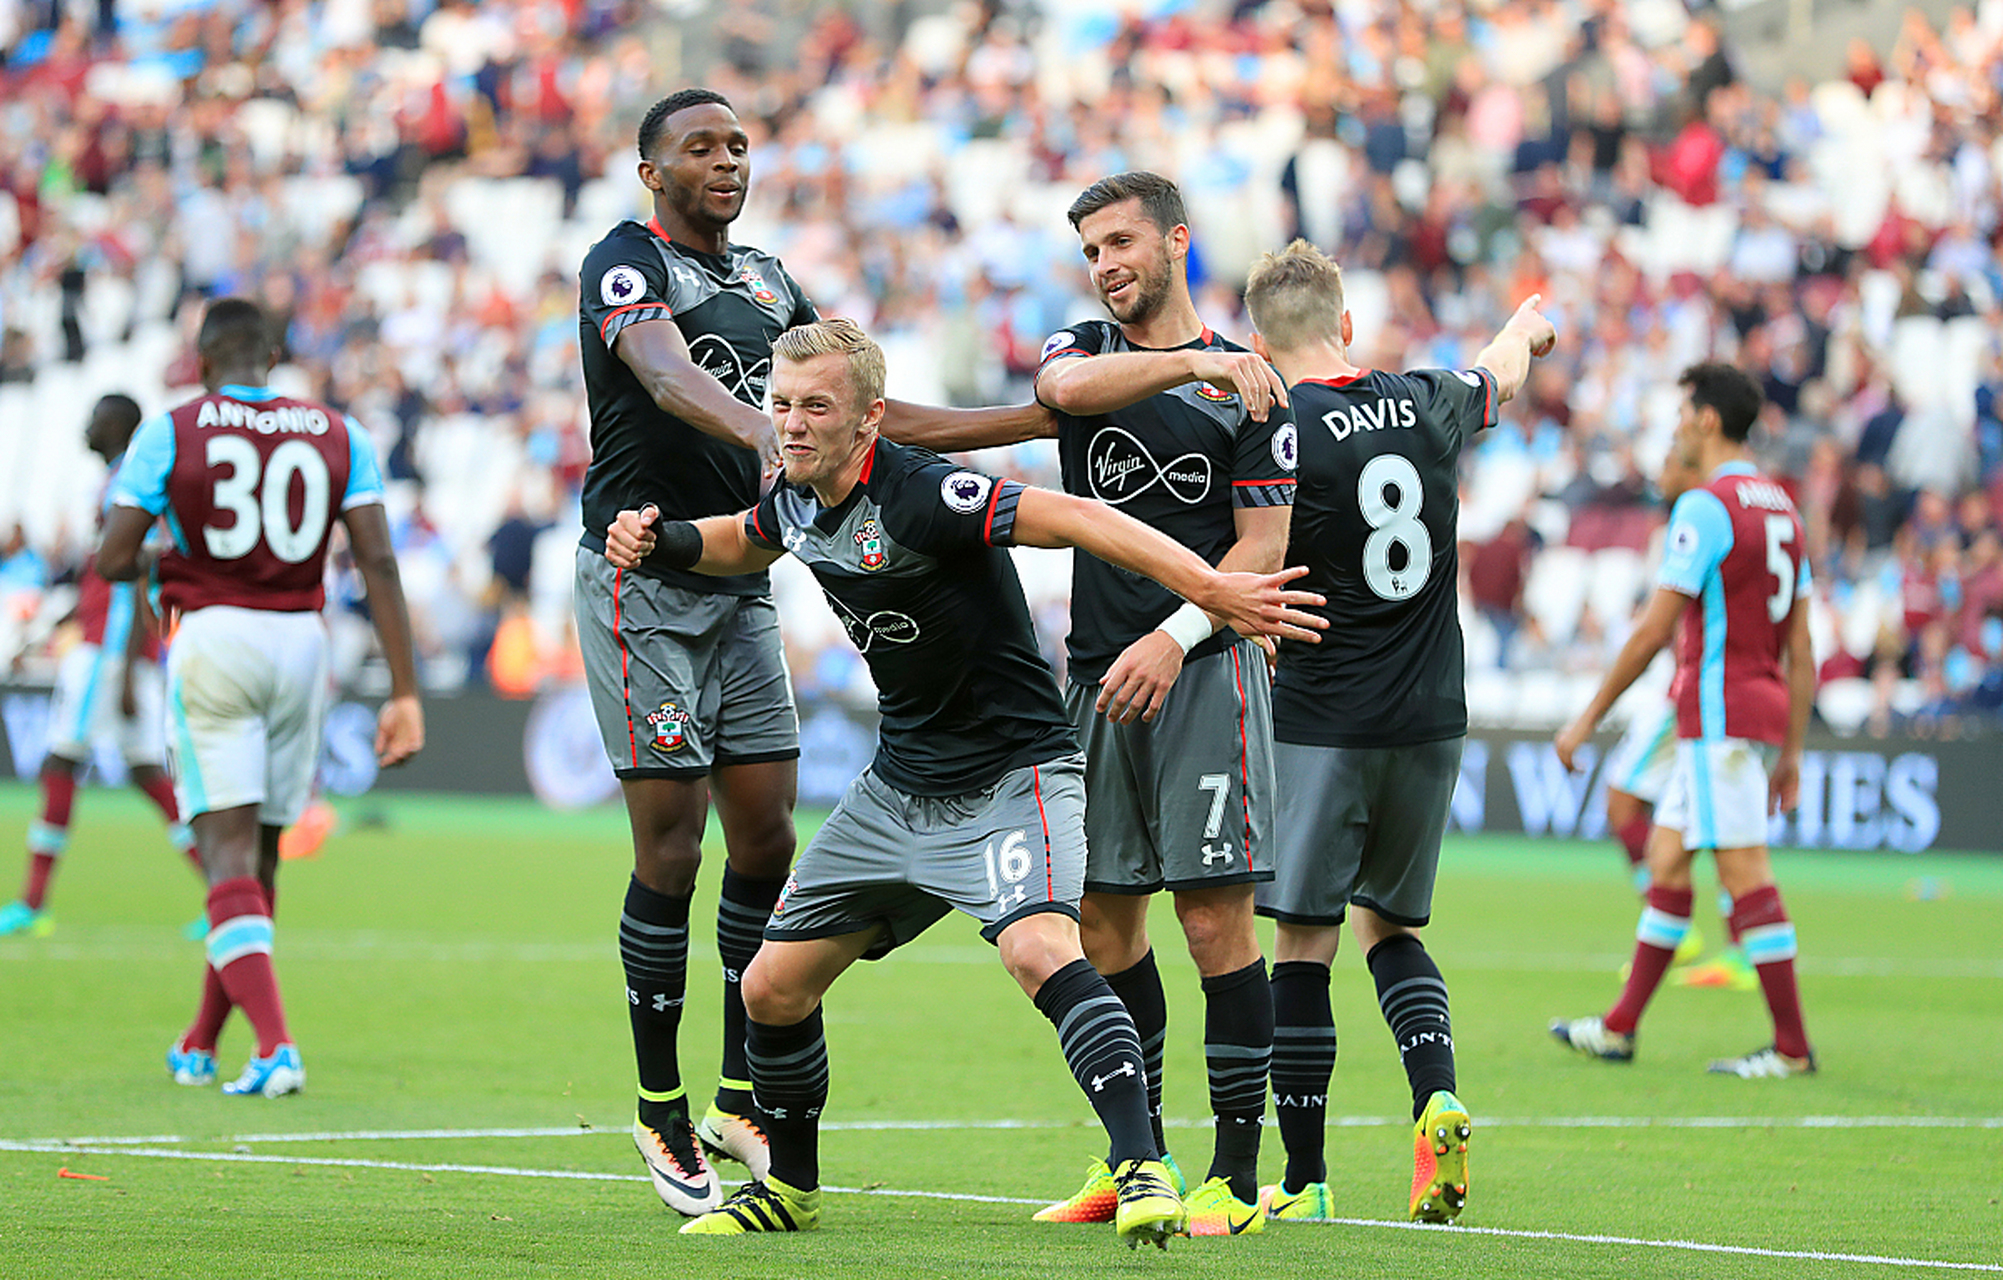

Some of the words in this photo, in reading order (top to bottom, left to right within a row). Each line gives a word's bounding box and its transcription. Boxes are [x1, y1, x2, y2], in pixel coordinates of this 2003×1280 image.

[197, 400, 330, 436] ANTONIO
[1321, 398, 1416, 442] DAVIS
[203, 434, 331, 564] 30
[1094, 441, 1146, 492] Virgin
[1168, 471, 1206, 484] media
[1357, 453, 1433, 601] 8
[1764, 513, 1795, 624] 5
[1198, 772, 1231, 838] 7
[982, 829, 1033, 900] 16
